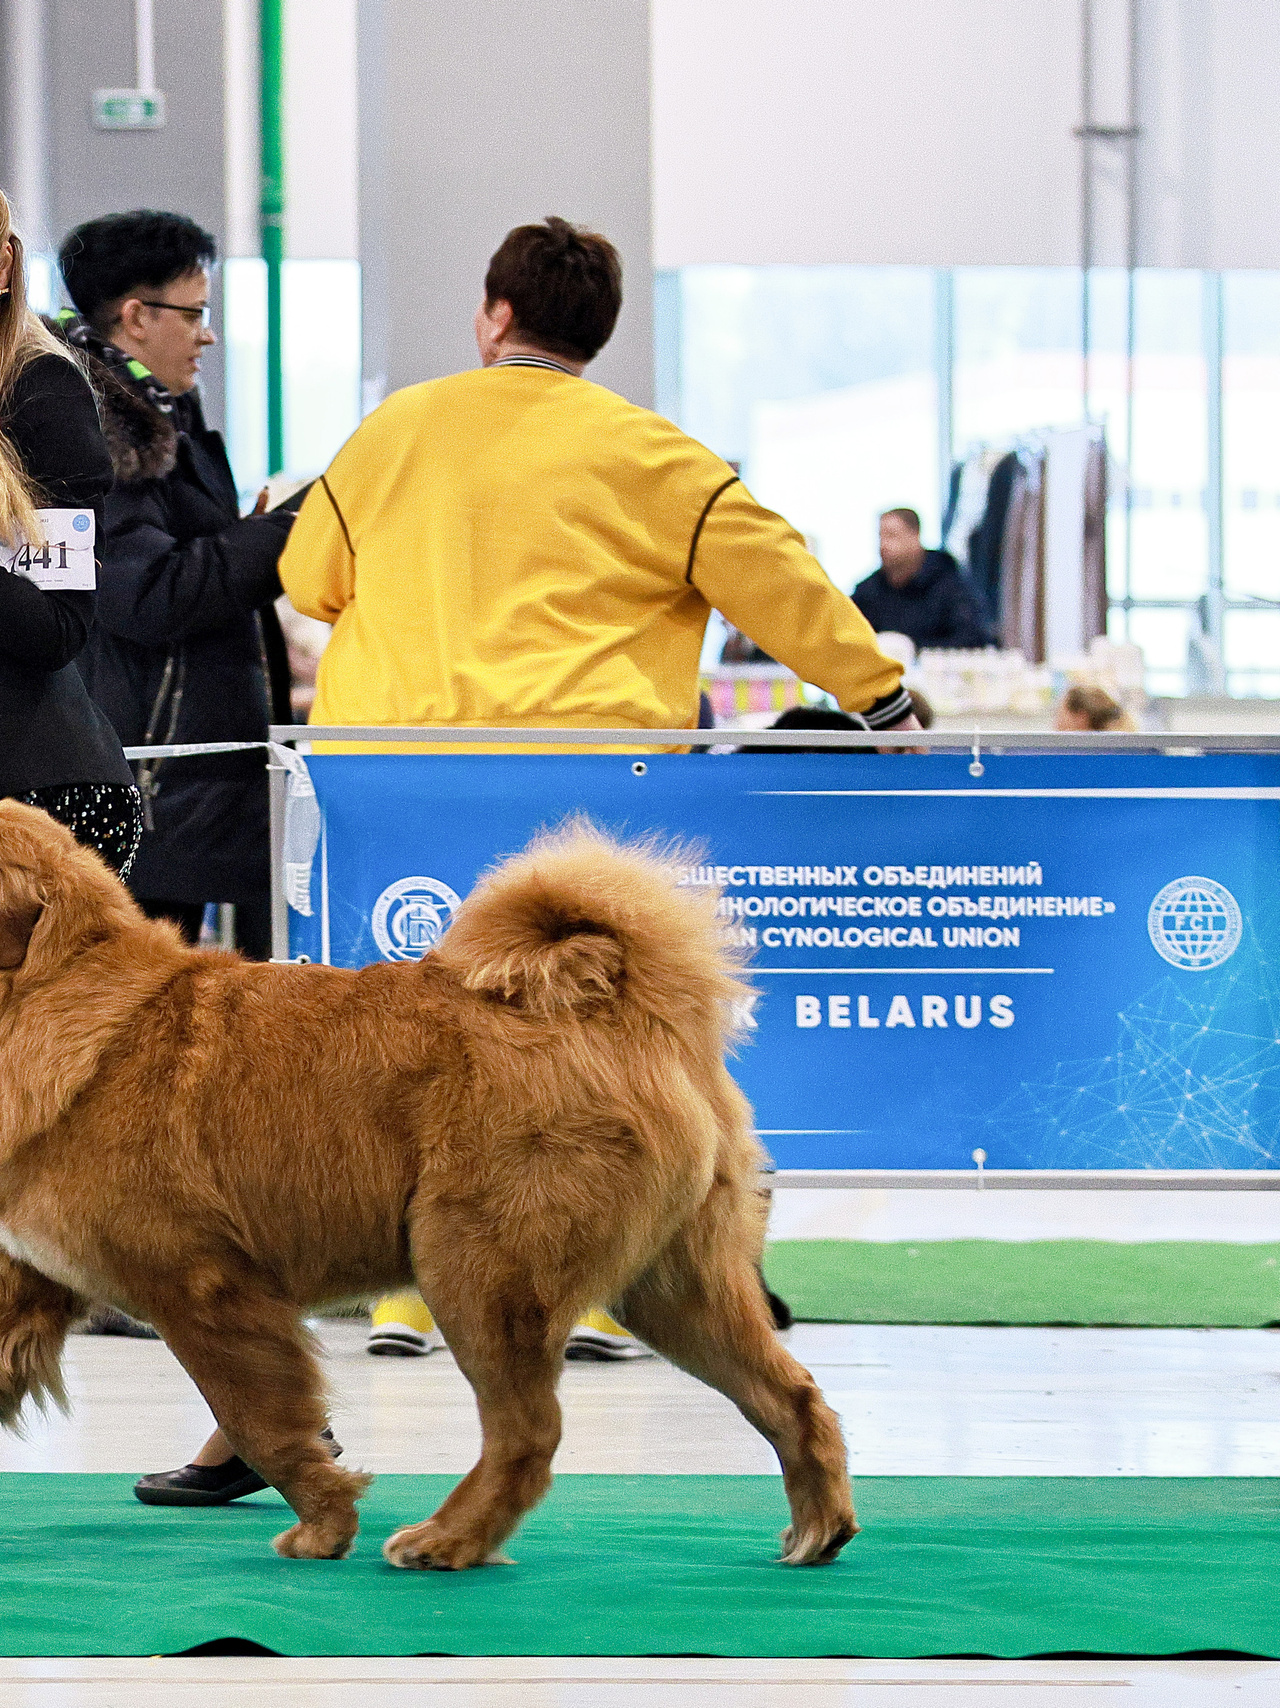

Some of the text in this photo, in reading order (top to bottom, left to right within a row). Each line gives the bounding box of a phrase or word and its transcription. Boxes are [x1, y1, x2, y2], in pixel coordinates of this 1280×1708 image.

[863, 861, 1043, 888] ОБЪЕДИНЕНИЙ
[927, 896, 1116, 918] ОБЪЕДИНЕНИЕ»
[1175, 915, 1214, 931] FCI
[762, 927, 938, 948] CYNOLOGICAL
[943, 927, 1020, 948] UNION
[796, 995, 1015, 1028] BELARUS
